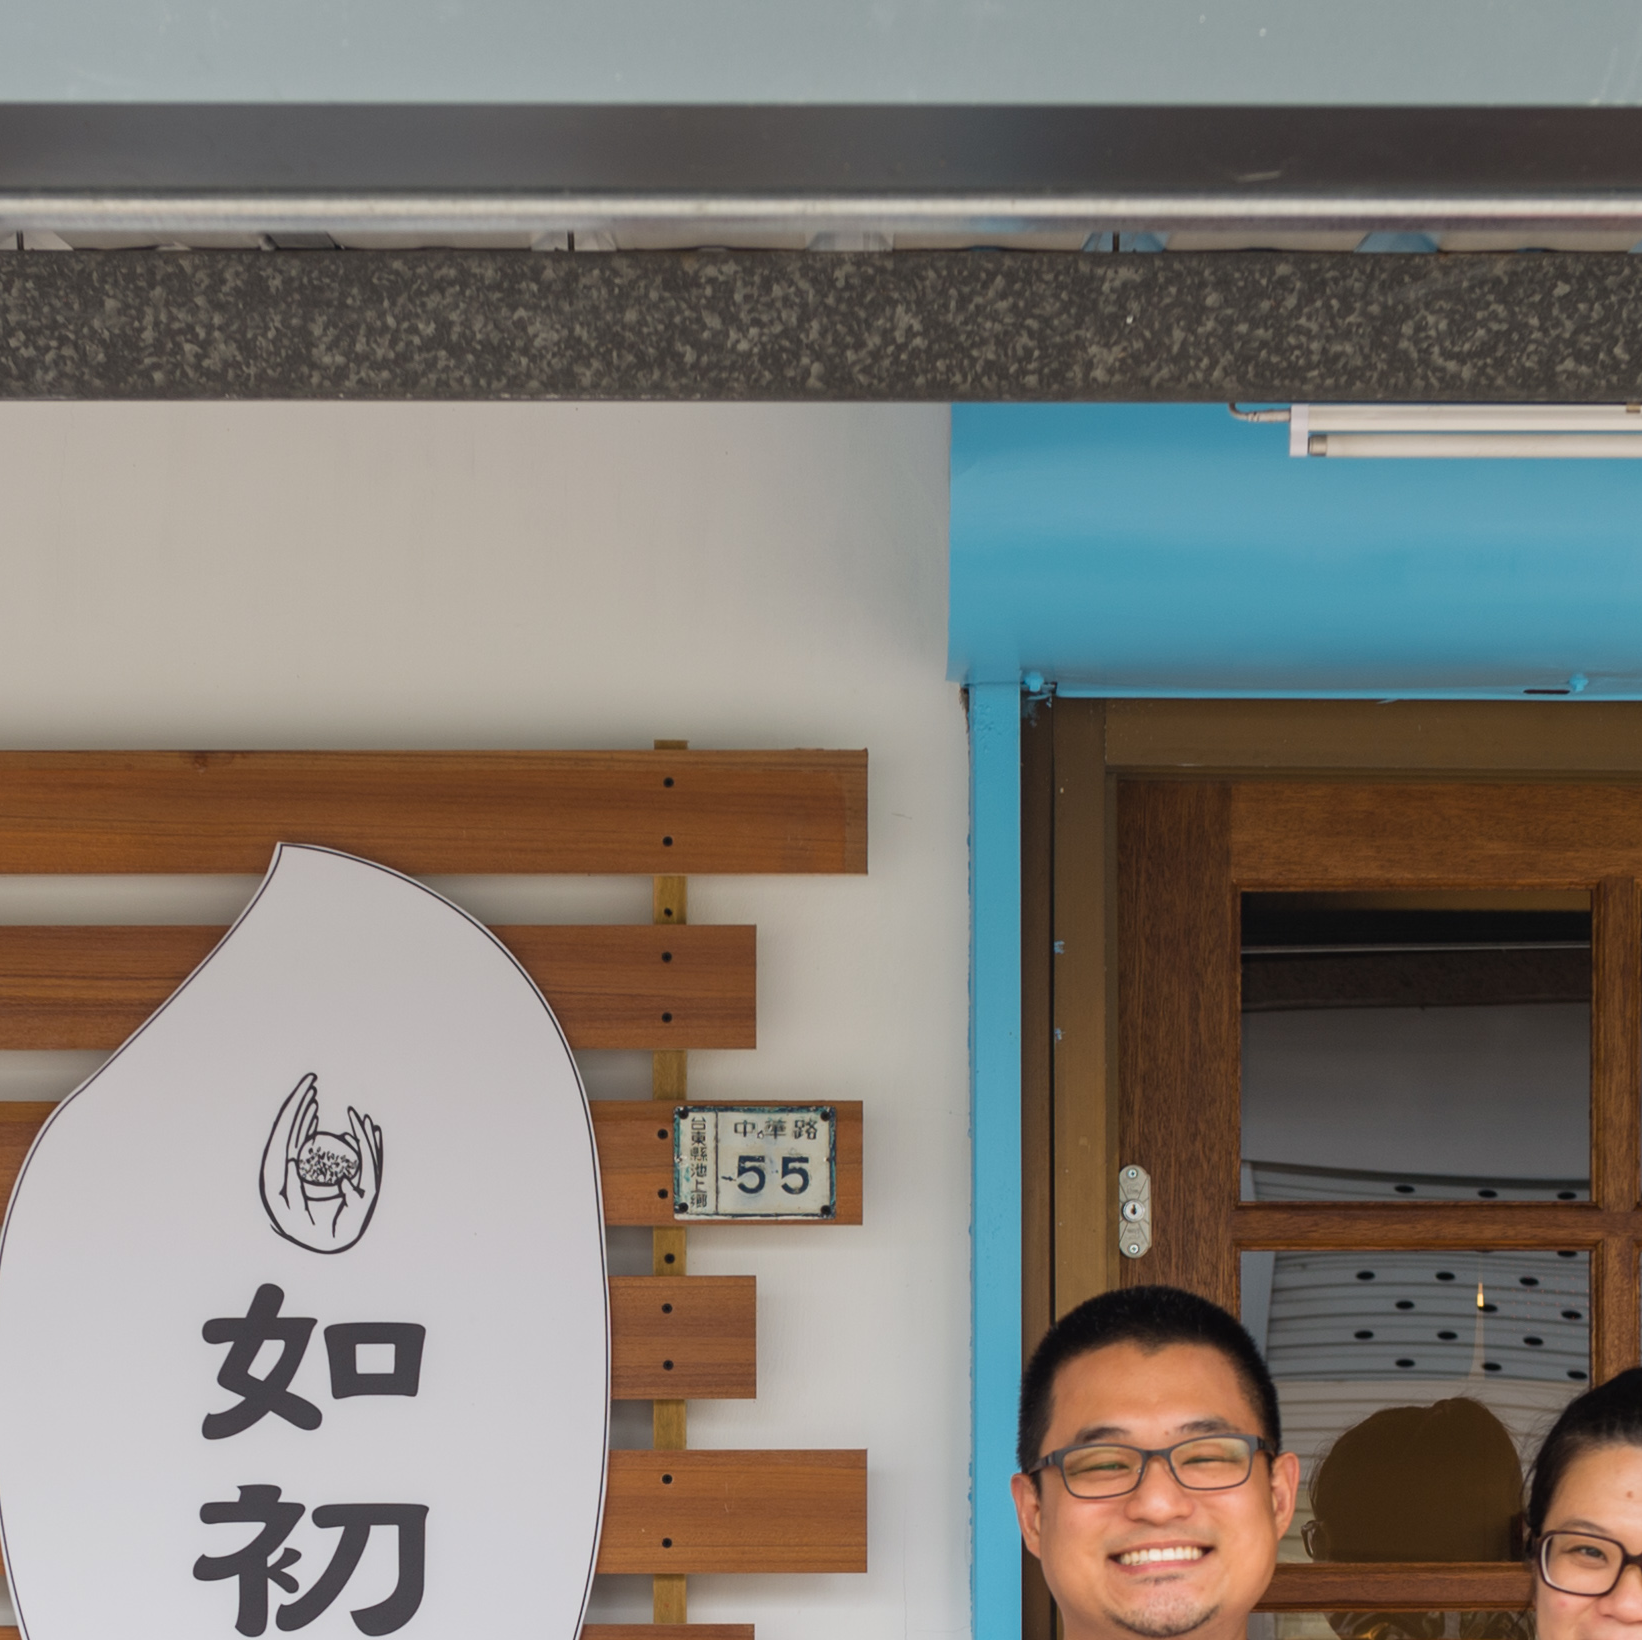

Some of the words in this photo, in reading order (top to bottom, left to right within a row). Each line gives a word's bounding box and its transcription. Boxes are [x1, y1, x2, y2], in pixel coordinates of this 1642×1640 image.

[734, 1118, 818, 1141] 中華路
[737, 1155, 810, 1195] 55
[193, 1283, 430, 1638] 如初
